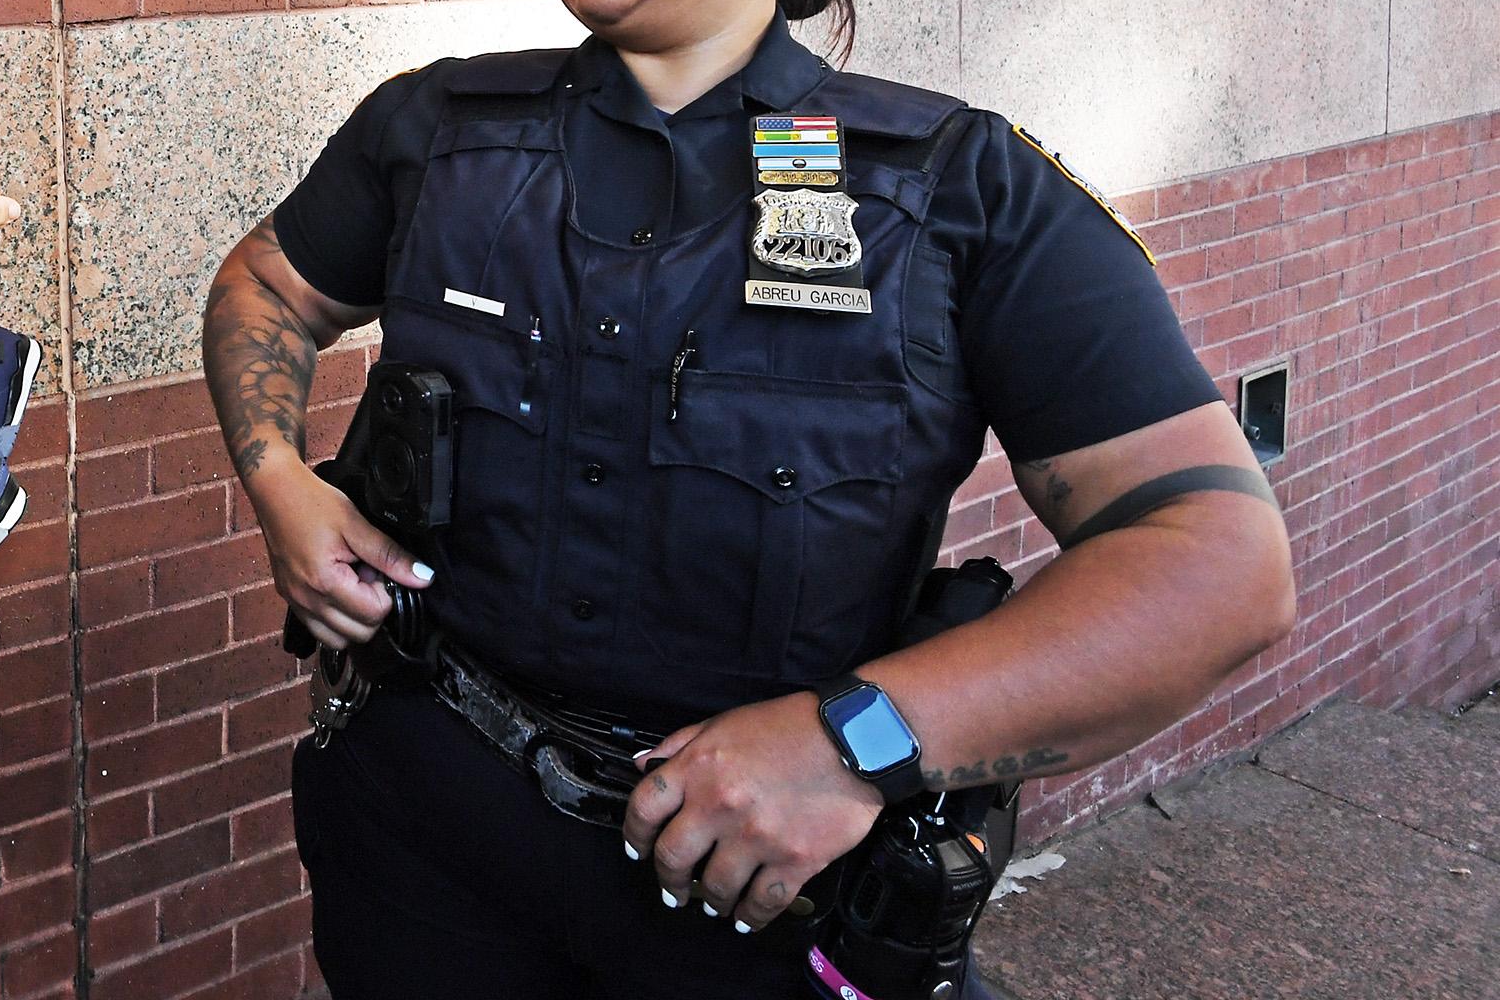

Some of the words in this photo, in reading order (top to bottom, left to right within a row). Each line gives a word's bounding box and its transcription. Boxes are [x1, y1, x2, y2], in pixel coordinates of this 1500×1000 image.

[766, 233, 849, 265] 22106
[751, 286, 801, 302] ABREU
[810, 290, 867, 308] GARCIA
